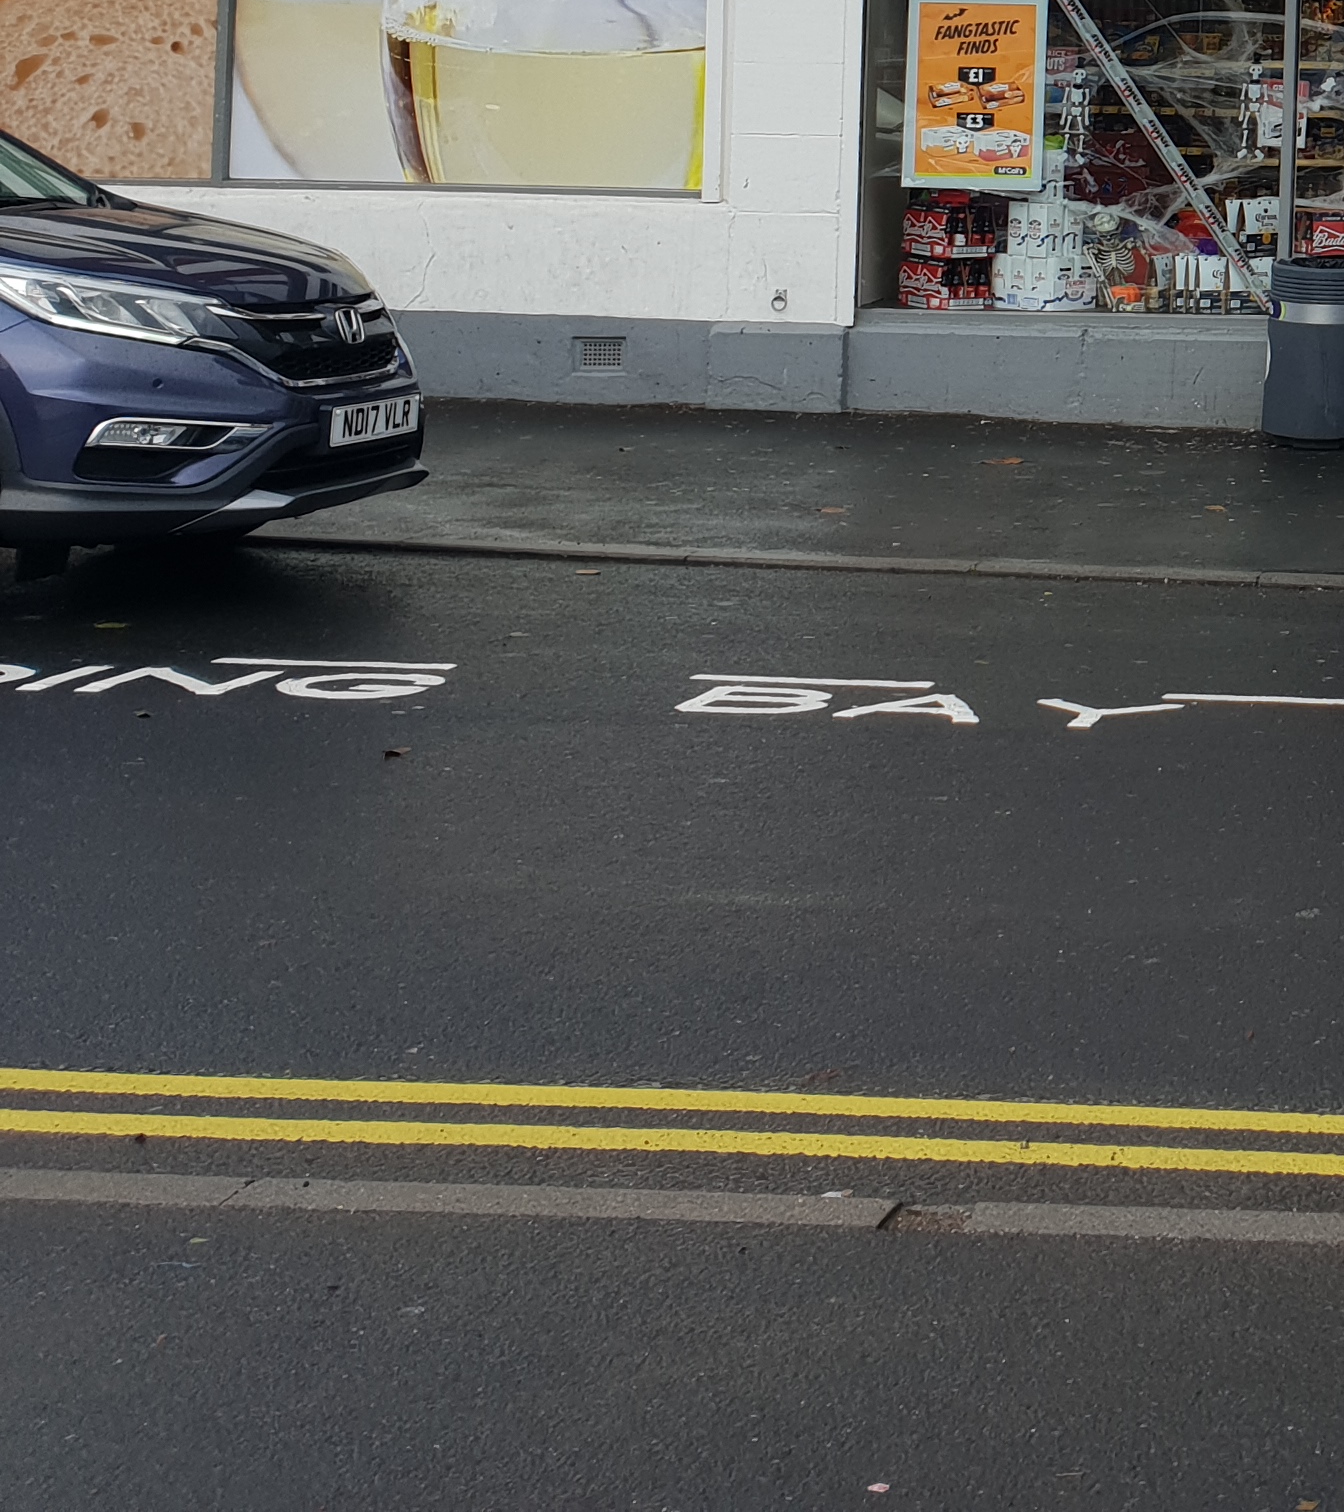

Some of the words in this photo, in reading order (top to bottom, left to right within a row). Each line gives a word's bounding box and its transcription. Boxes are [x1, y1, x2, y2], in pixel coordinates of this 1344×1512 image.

[934, 19, 1020, 41] FANGTASTIC
[957, 38, 999, 56] FINDS
[1046, 57, 1066, 70] UTS
[968, 68, 984, 83] £1
[966, 114, 984, 128] £3
[342, 405, 380, 439] ND17
[385, 399, 411, 431] VLR
[0, 663, 447, 700] ING
[674, 686, 1185, 728] BAY
